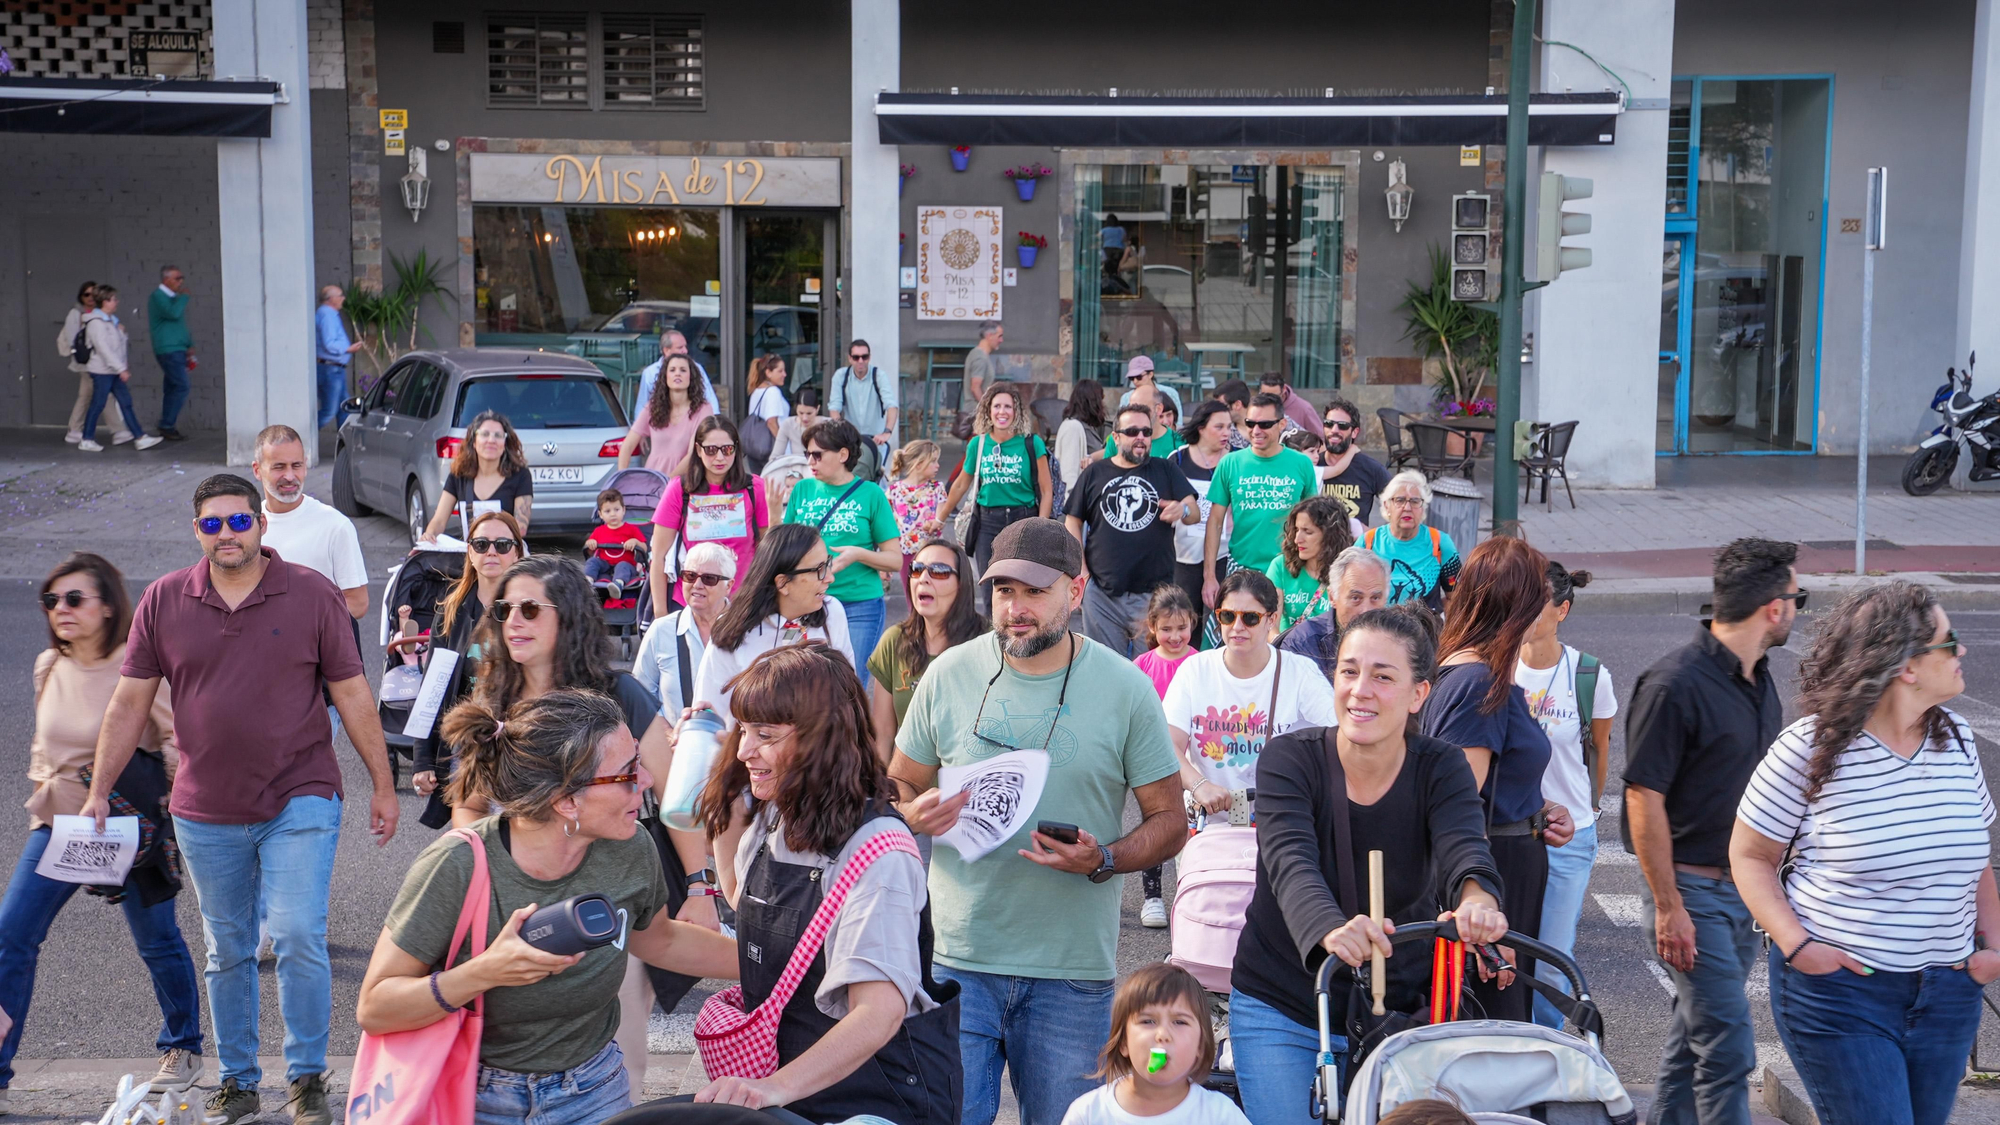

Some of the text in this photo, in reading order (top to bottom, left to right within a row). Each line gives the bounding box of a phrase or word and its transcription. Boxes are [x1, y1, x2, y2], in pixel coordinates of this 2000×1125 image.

[130, 34, 196, 50] SE ALQUILA
[684, 156, 717, 194] de
[722, 159, 767, 205] 12
[1841, 219, 1859, 233] 23
[958, 287, 969, 300] 12
[533, 468, 580, 480] 142 KCV
[1245, 490, 1257, 499] DE
[1322, 483, 1361, 499] UNDRA
[1285, 590, 1312, 604] SCUEL
